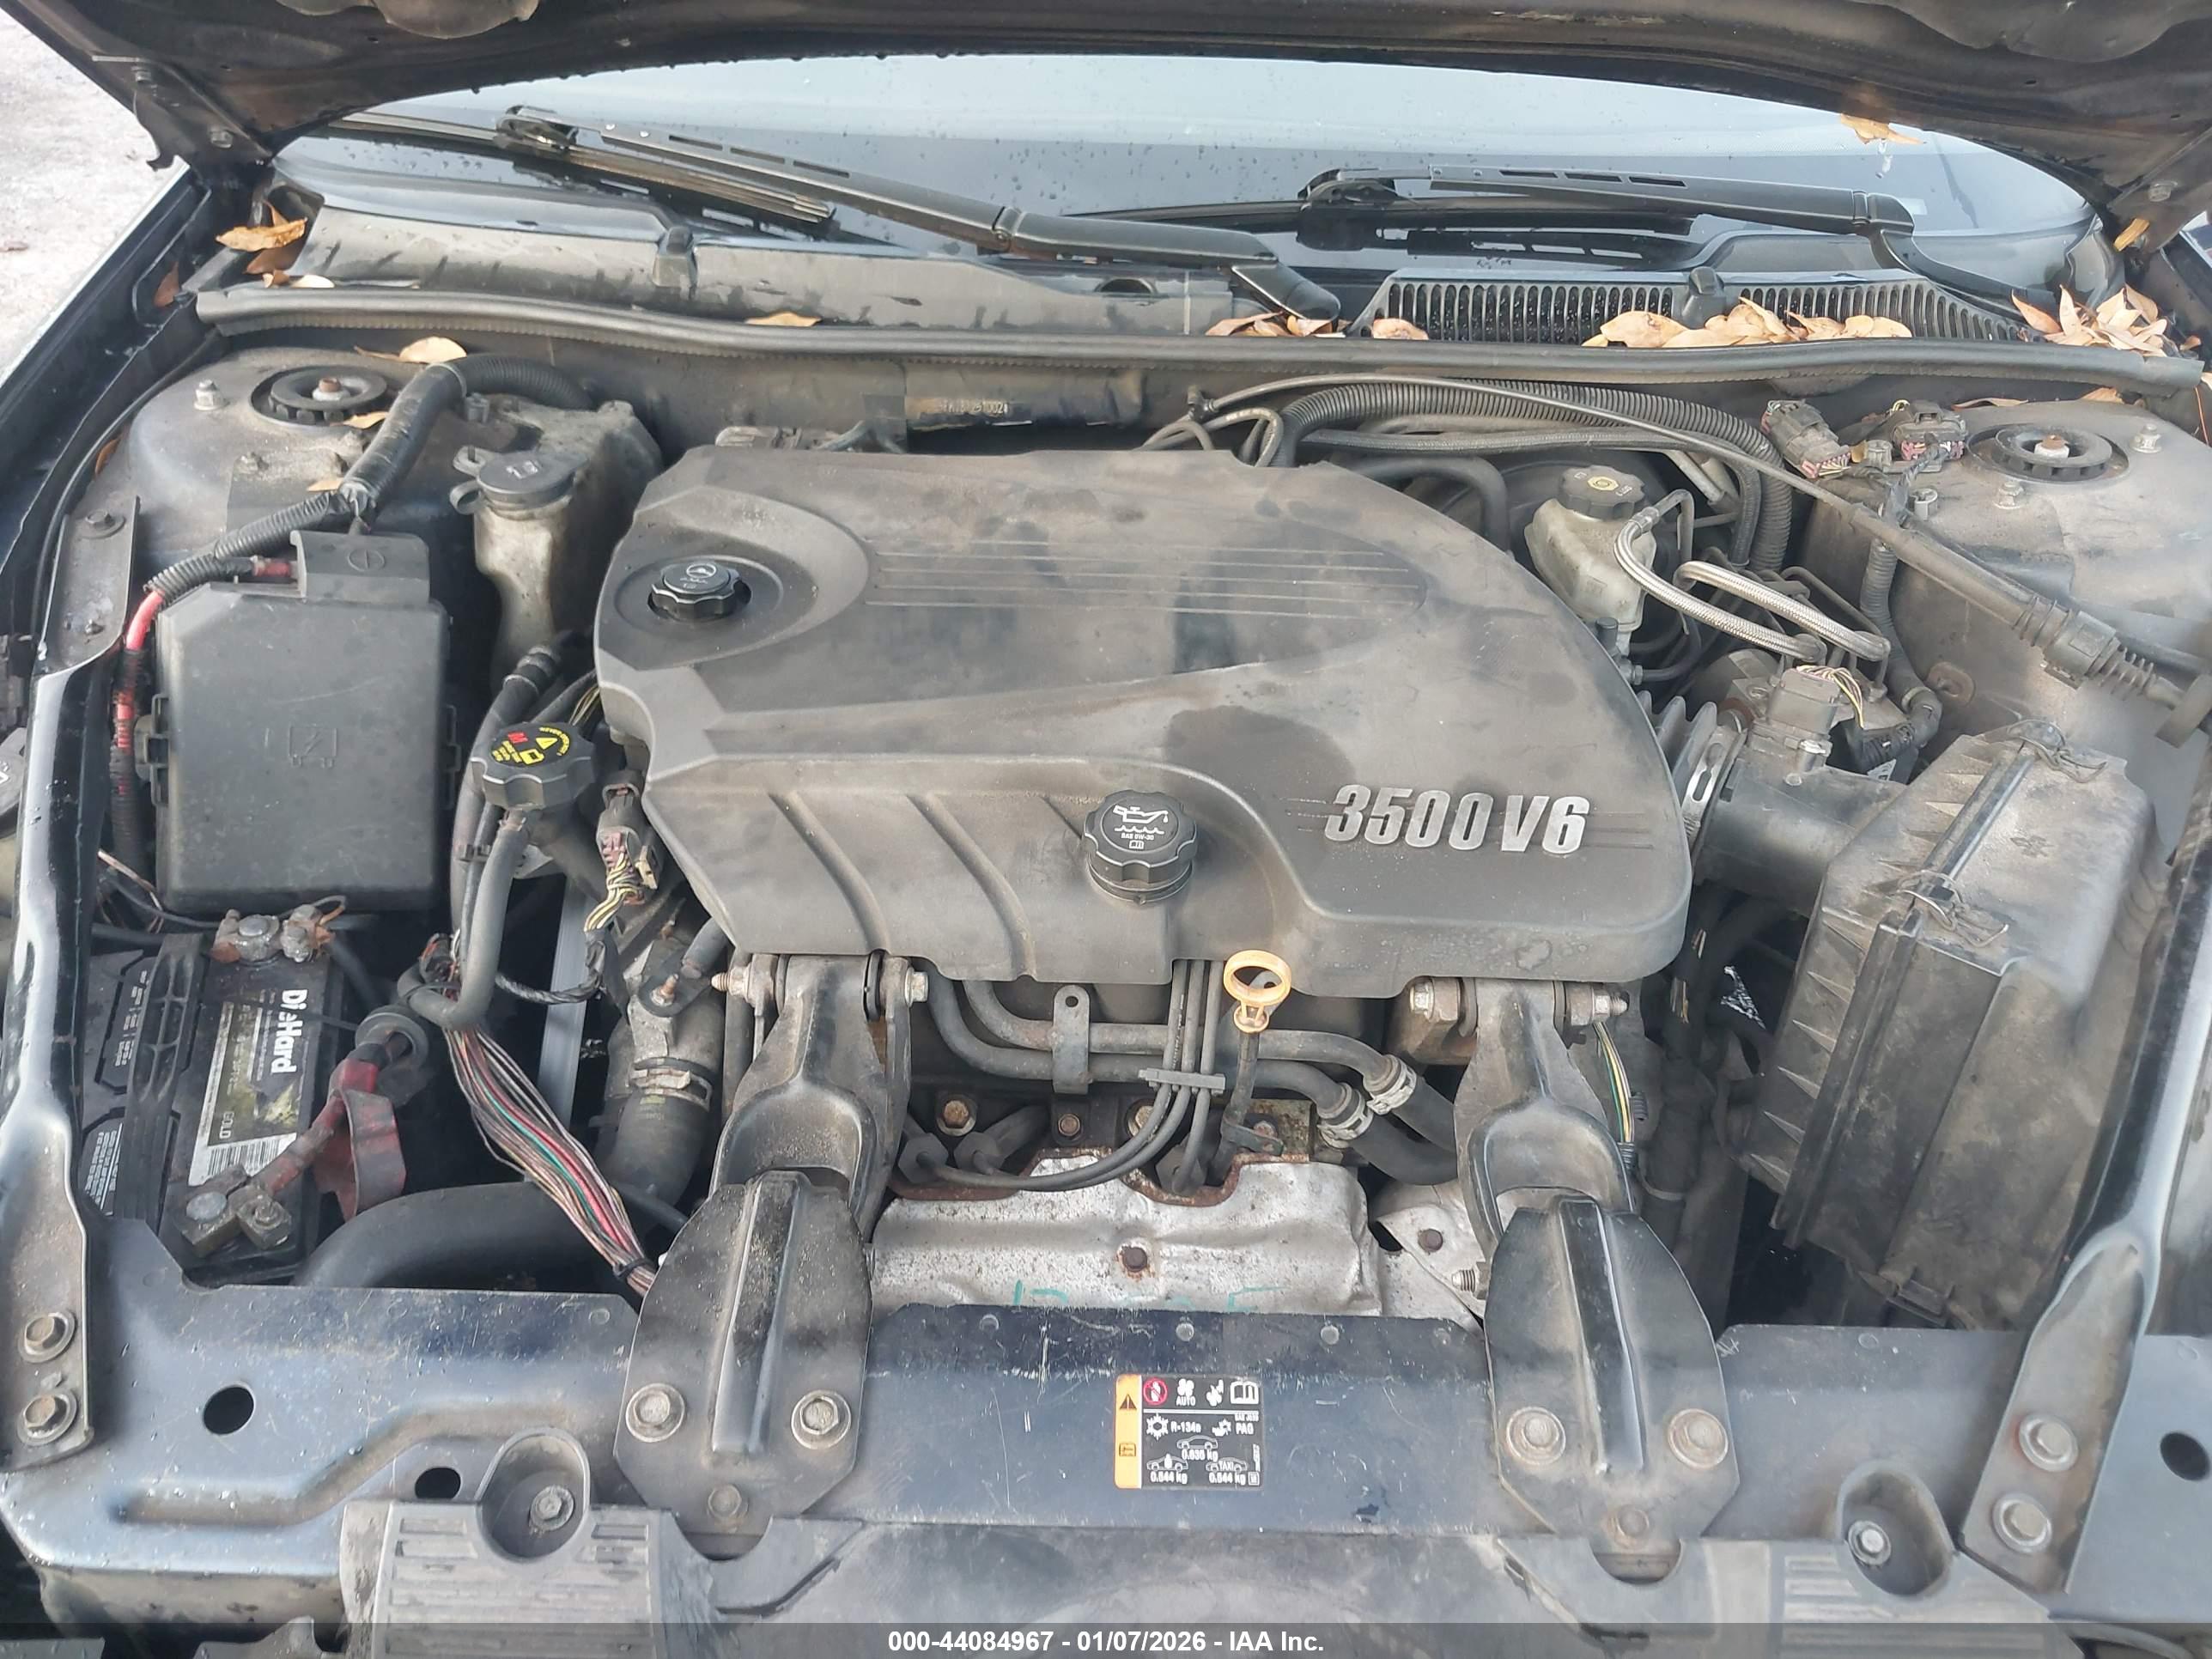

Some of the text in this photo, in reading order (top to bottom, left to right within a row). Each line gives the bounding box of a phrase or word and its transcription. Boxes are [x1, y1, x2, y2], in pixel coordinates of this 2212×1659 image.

[1325, 784, 1590, 854] 3500 V6
[270, 988, 307, 1074] DieHard
[1176, 1396, 1196, 1407] AUTO
[1170, 1420, 1201, 1433] R-134a
[1206, 1449, 1218, 1462] kg
[1218, 1461, 1234, 1471] TAXI
[1176, 1471, 1188, 1485] kg
[1235, 1472, 1246, 1486] kg
